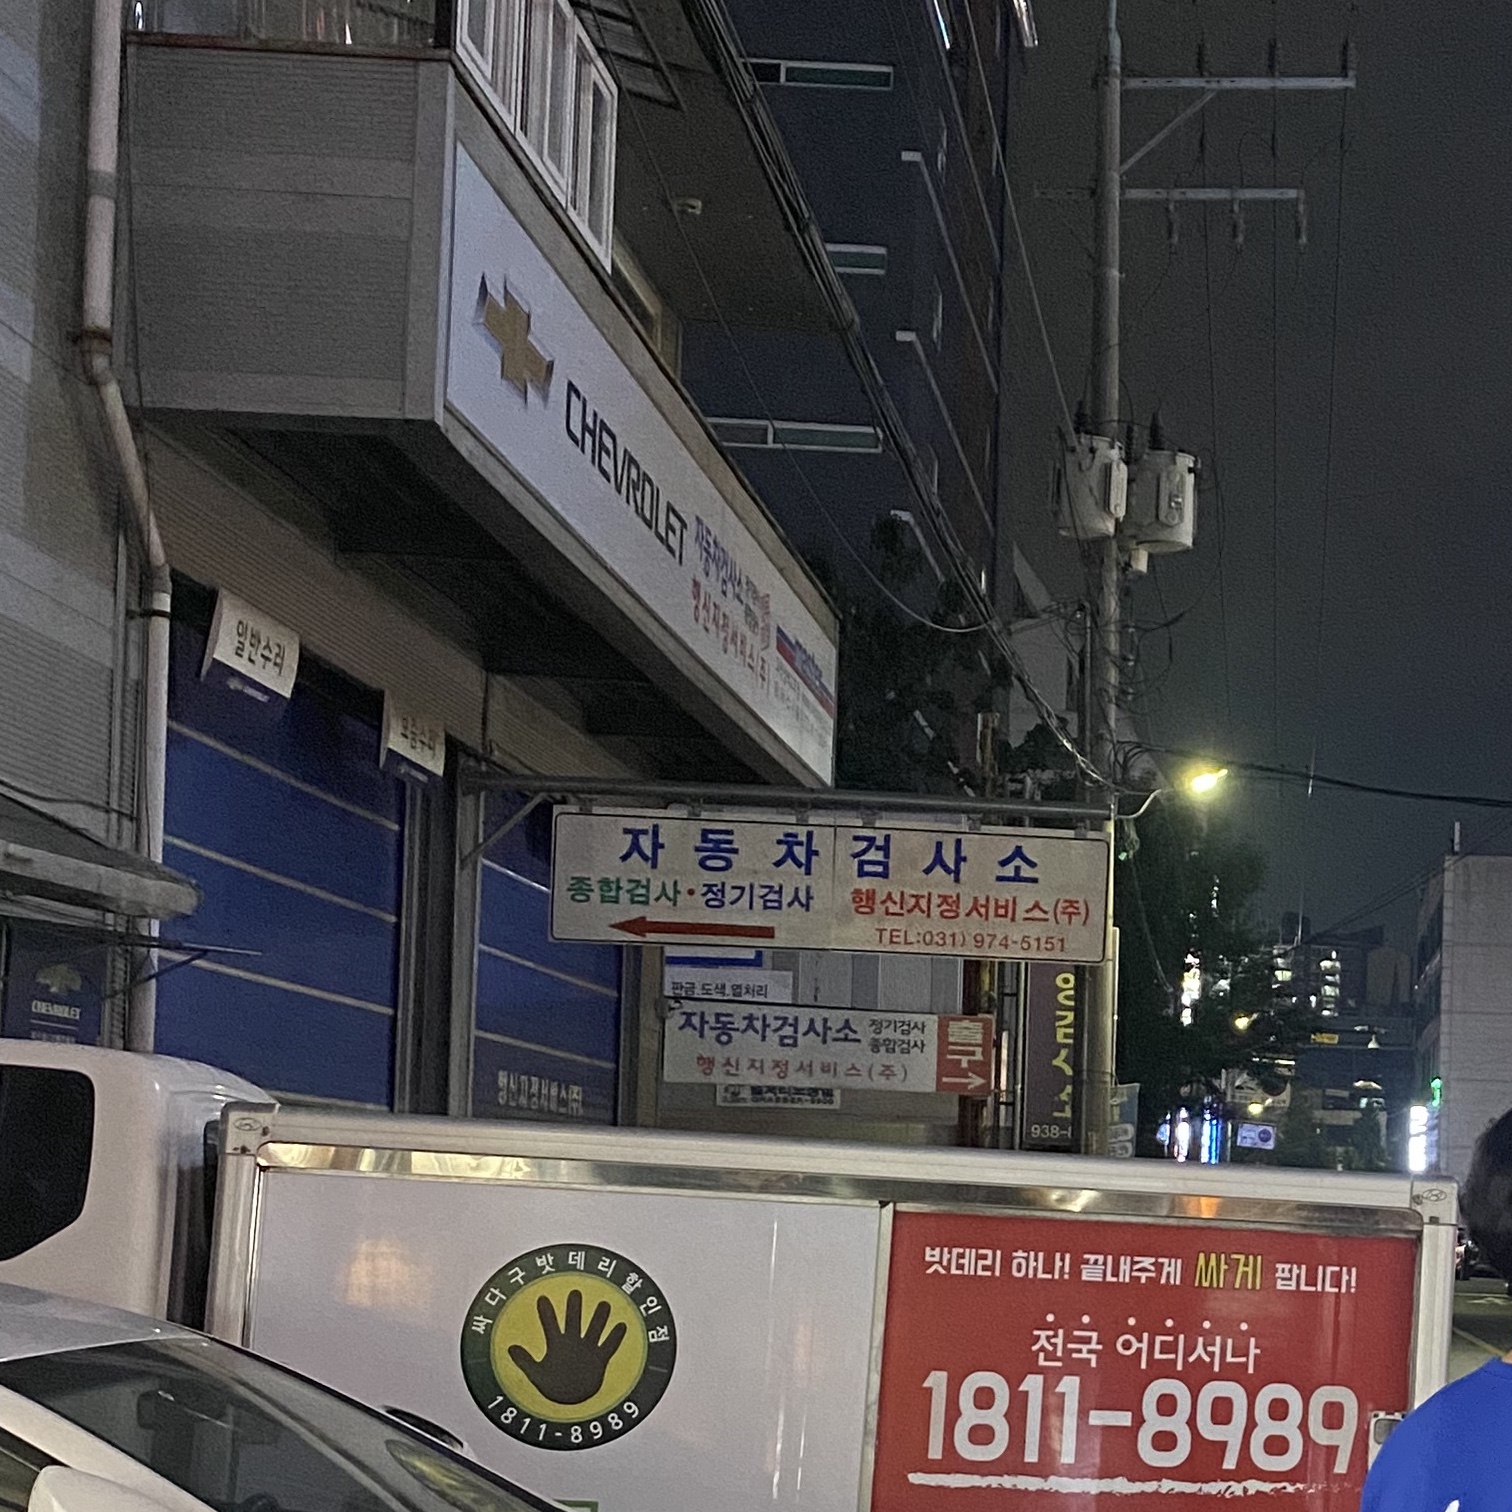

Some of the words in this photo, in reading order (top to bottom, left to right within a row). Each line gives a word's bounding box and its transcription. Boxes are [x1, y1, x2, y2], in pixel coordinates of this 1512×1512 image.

[564, 379, 688, 567] CHEVROLET
[234, 618, 287, 678] 일반수리
[619, 823, 1040, 884] 자동차검사소
[850, 888, 1090, 927] 행신지정서비스(주)
[973, 934, 1066, 953] 974-5151
[678, 1011, 861, 1049] 자동차검사소
[868, 1018, 926, 1035] 정기검사
[697, 1054, 907, 1081] 행신지정서비스(주)
[1031, 1125, 1072, 1138] 938-
[924, 1246, 1001, 1276] 밧데리
[1011, 1250, 1070, 1280] 하나!
[1080, 1254, 1182, 1286] 끝내주게
[1195, 1252, 1262, 1290] 싸게
[1275, 1263, 1357, 1294] 팝니다!
[1030, 1329, 1103, 1367] 전국
[1115, 1332, 1261, 1374] 어디서나
[487, 1395, 640, 1444] 1811-8989
[922, 1370, 1359, 1475] 1811-8989
